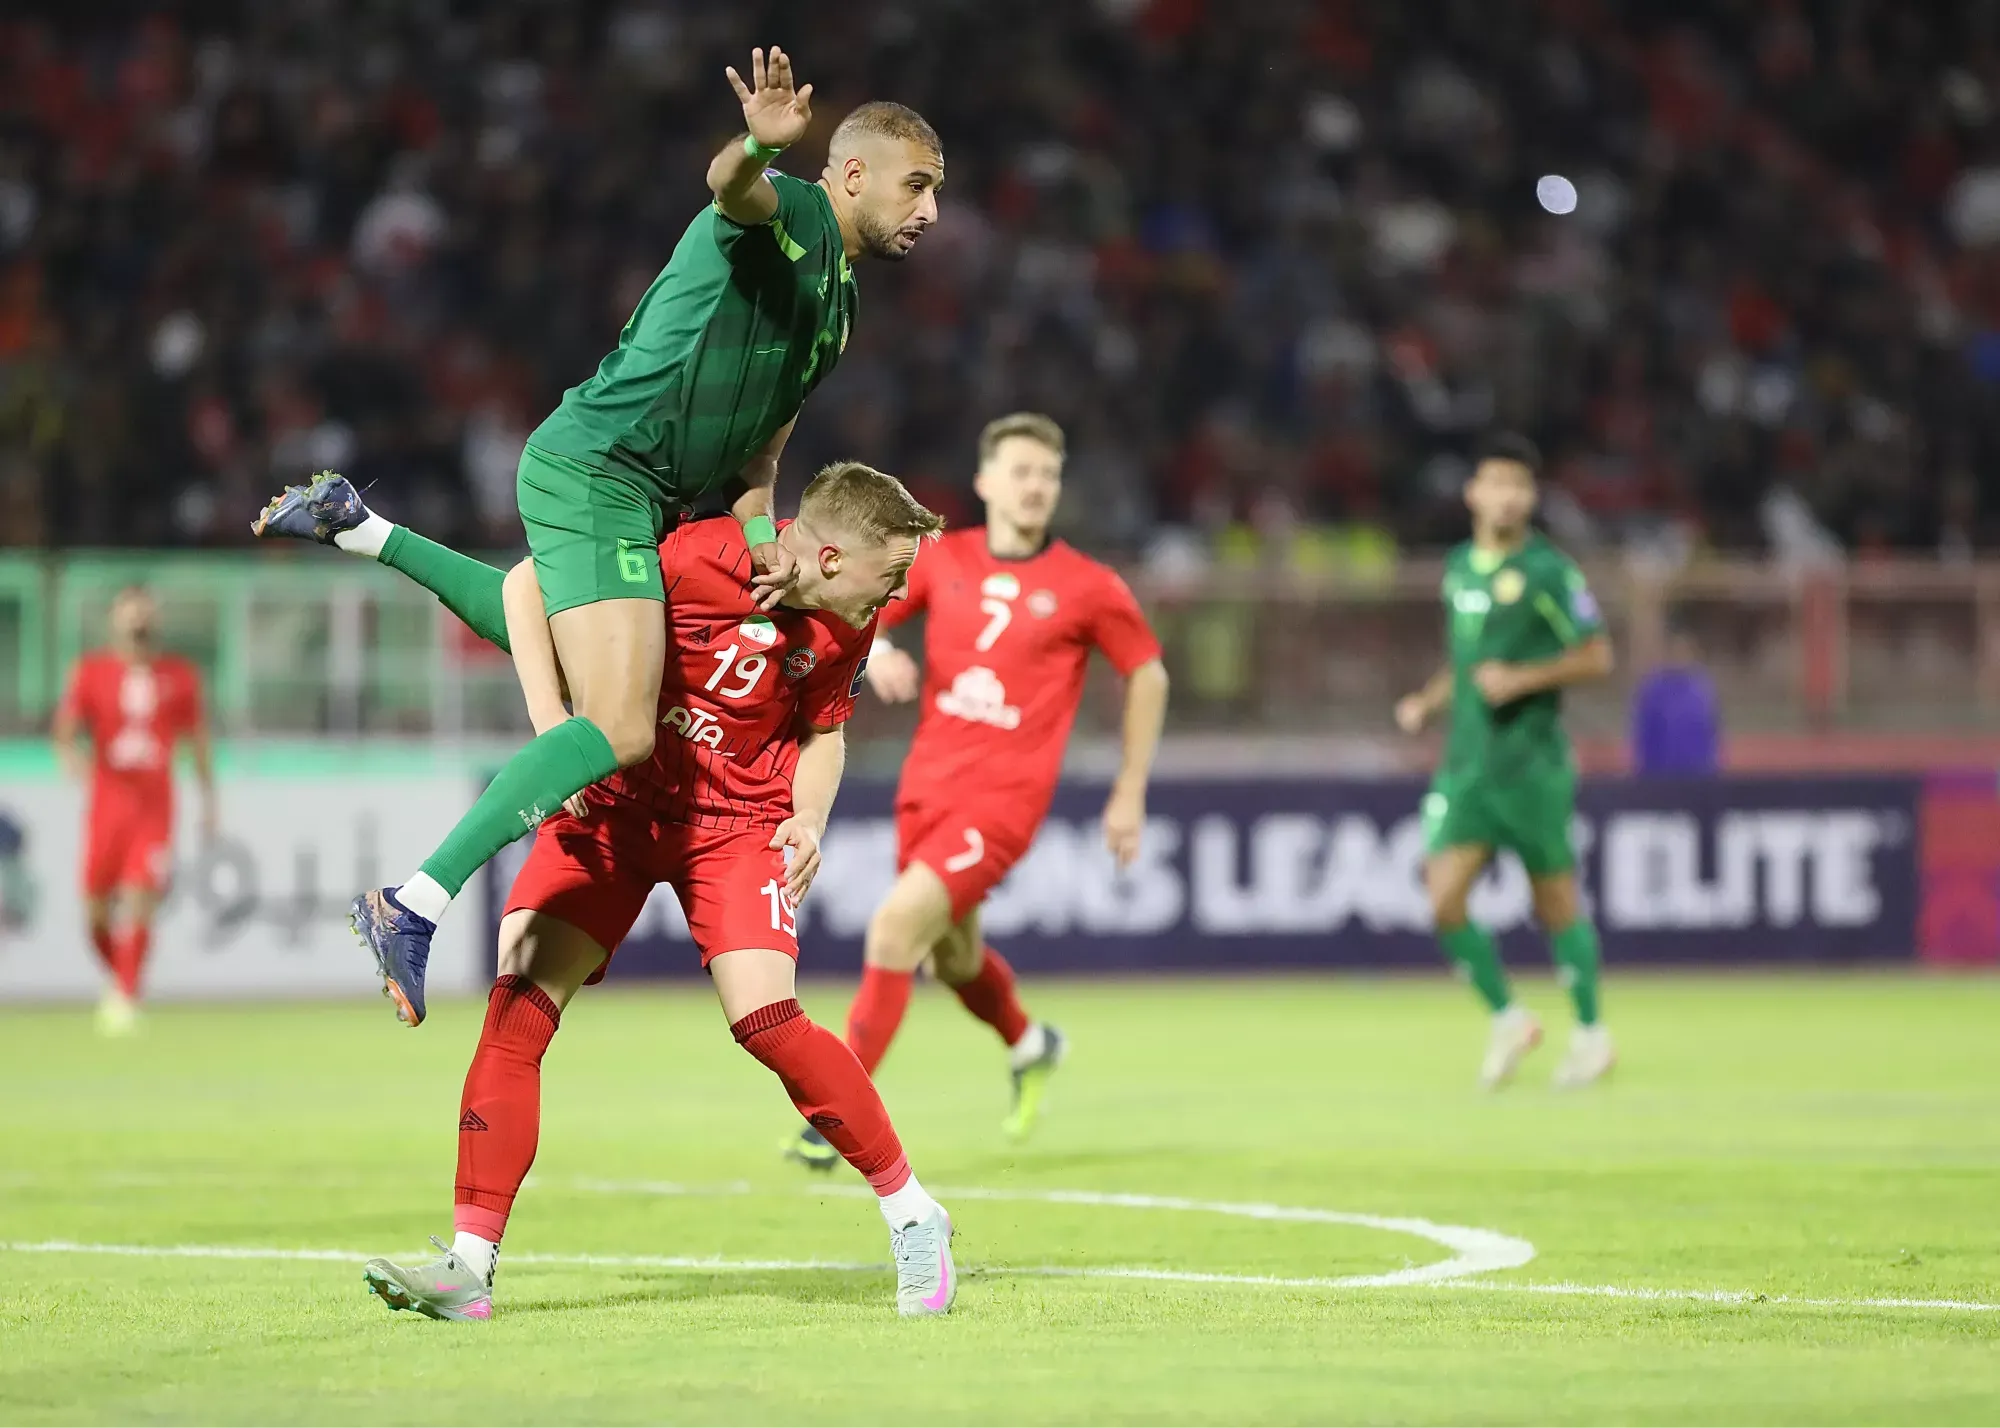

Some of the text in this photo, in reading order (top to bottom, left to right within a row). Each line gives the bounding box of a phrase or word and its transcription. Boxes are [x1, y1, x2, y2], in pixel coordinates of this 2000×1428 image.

[616, 537, 649, 583] 6
[975, 598, 1012, 652] 7
[704, 643, 767, 699] 19
[661, 706, 724, 749] ATA
[944, 826, 984, 873] 7
[1605, 810, 1882, 929] ELITE
[760, 878, 797, 938] 19
